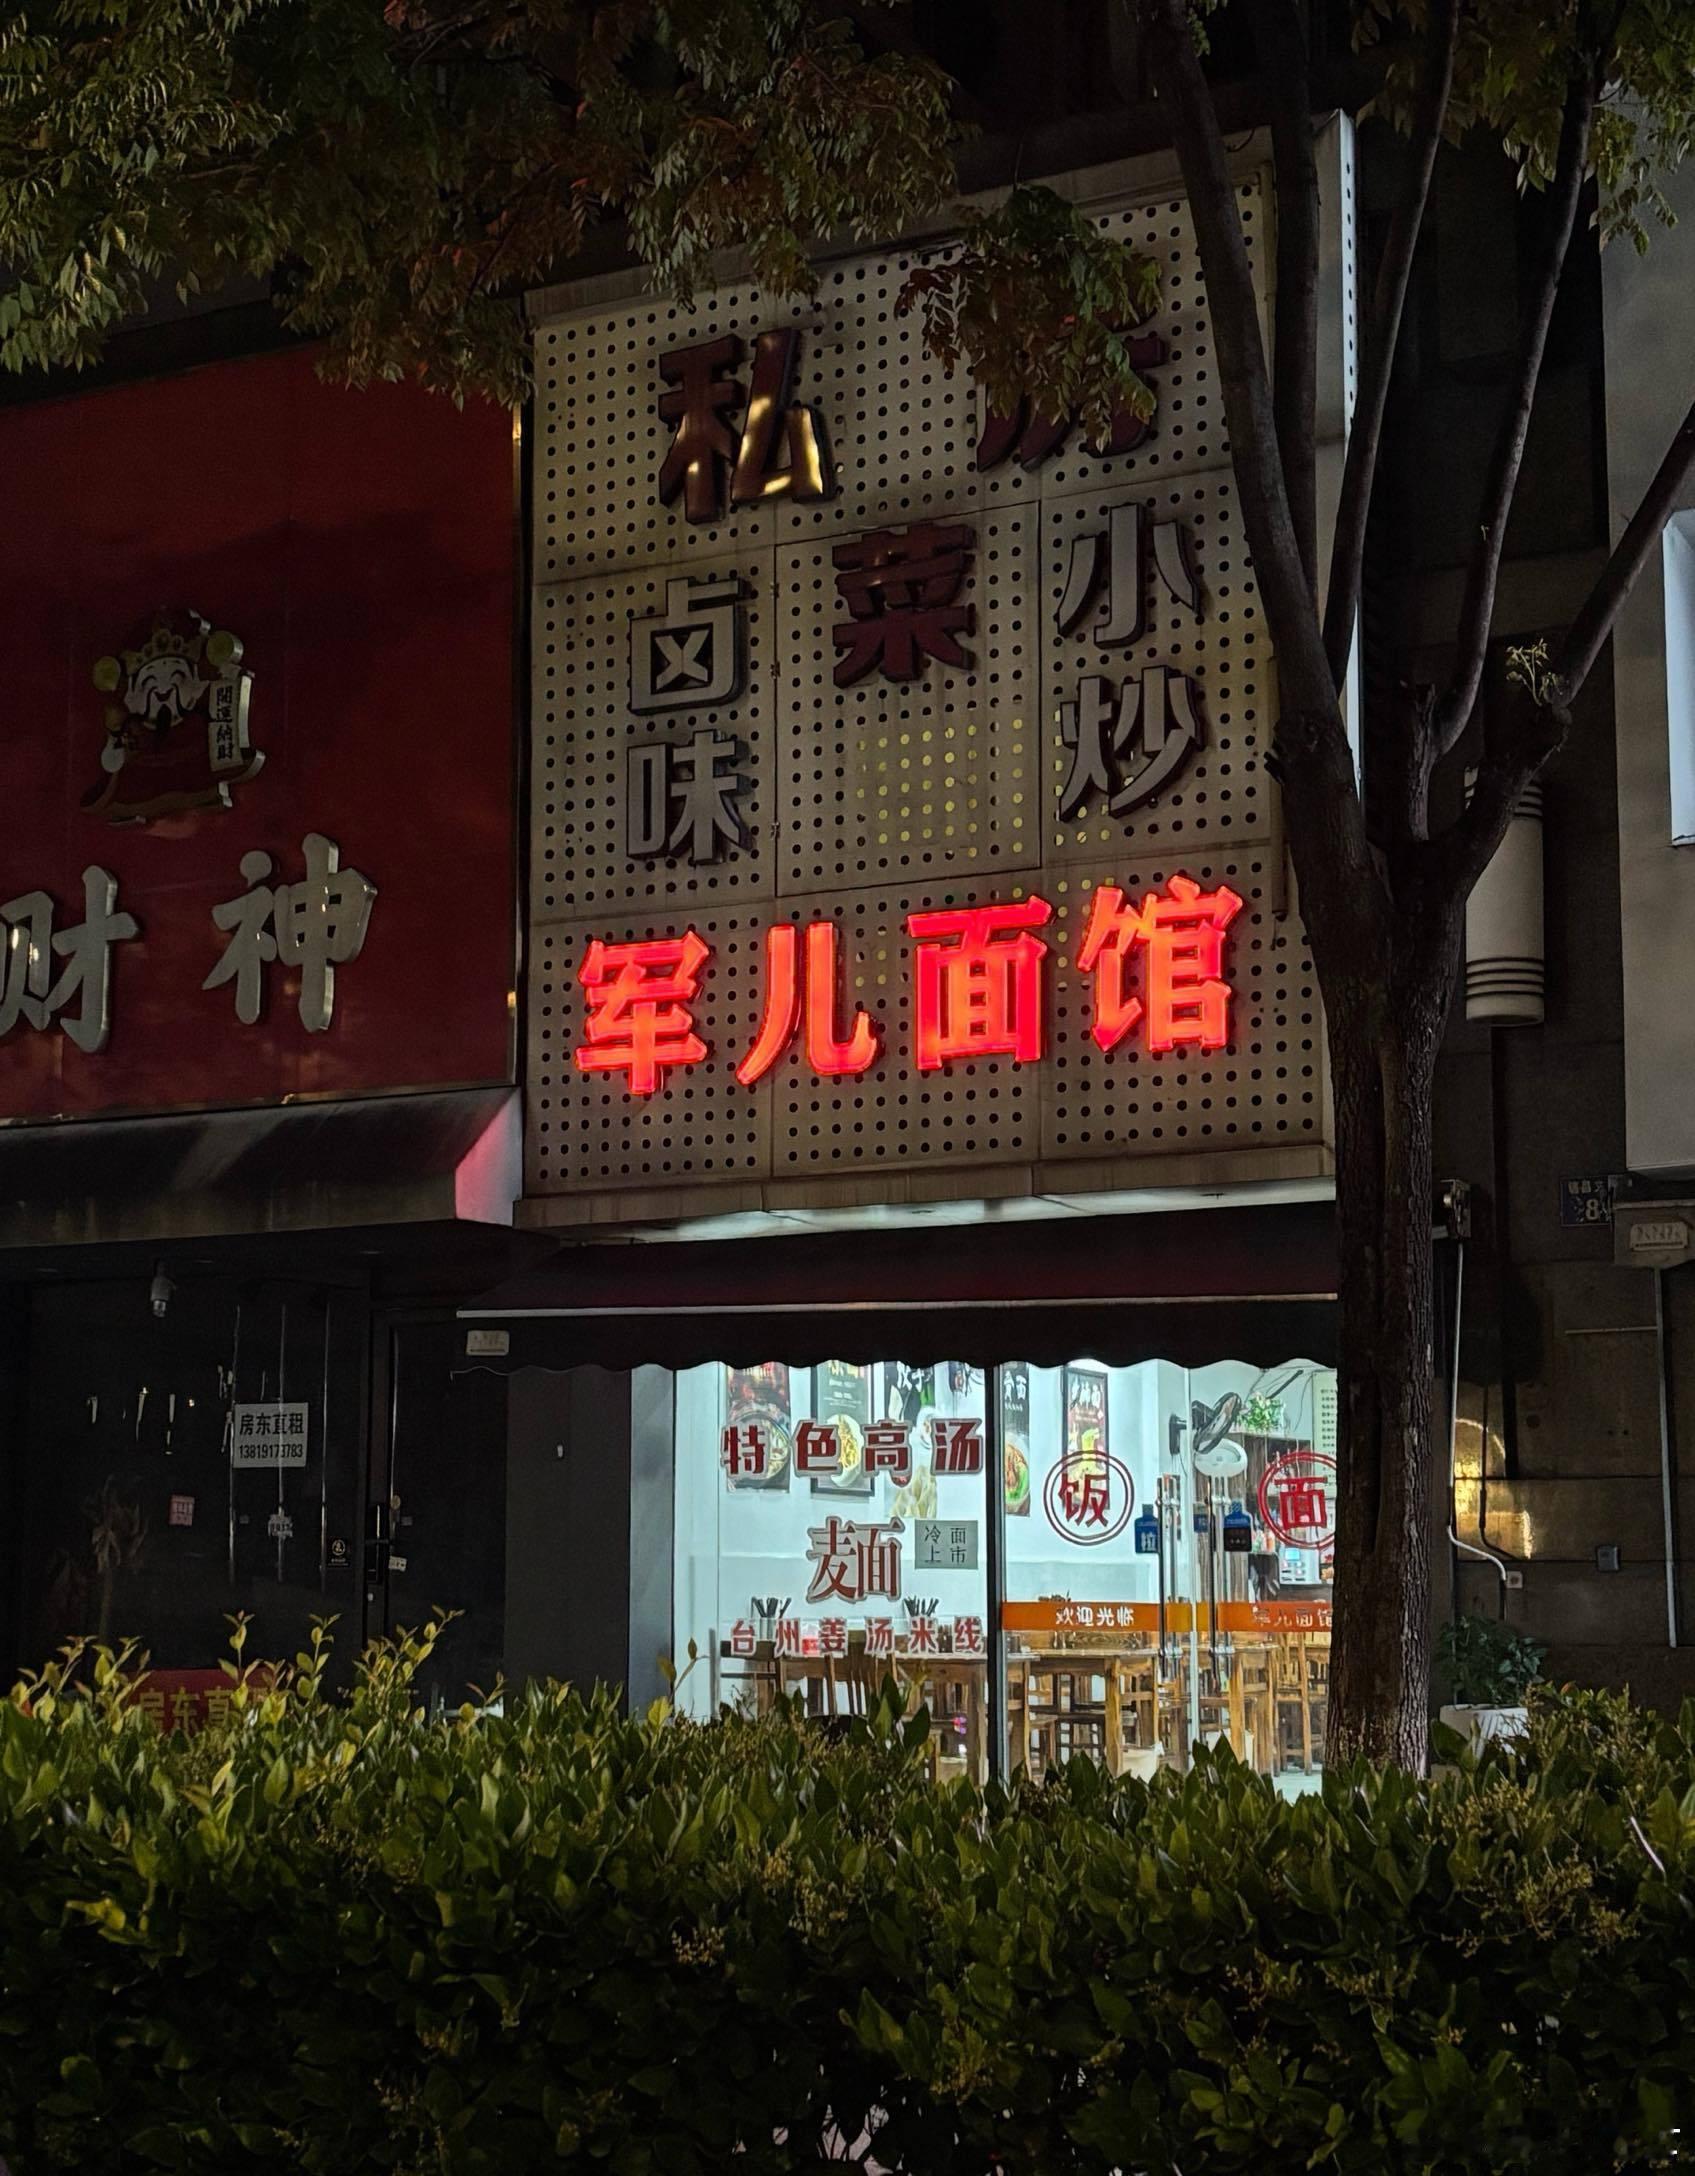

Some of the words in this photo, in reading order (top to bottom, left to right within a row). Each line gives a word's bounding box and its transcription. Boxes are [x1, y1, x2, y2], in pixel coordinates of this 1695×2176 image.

[1058, 502, 1203, 822] 小炒
[626, 576, 752, 865] 卤味
[573, 873, 1244, 1096] 军儿面馆
[722, 1420, 982, 1475] 特色高汤
[1058, 1472, 1109, 1527] 饭
[1274, 1476, 1328, 1529] 面
[924, 1545, 967, 1564] 上市
[925, 1524, 967, 1544] 冷面
[731, 1617, 984, 1657] 台州姜汤米线
[1056, 1606, 1134, 1627] 欢迎光临
